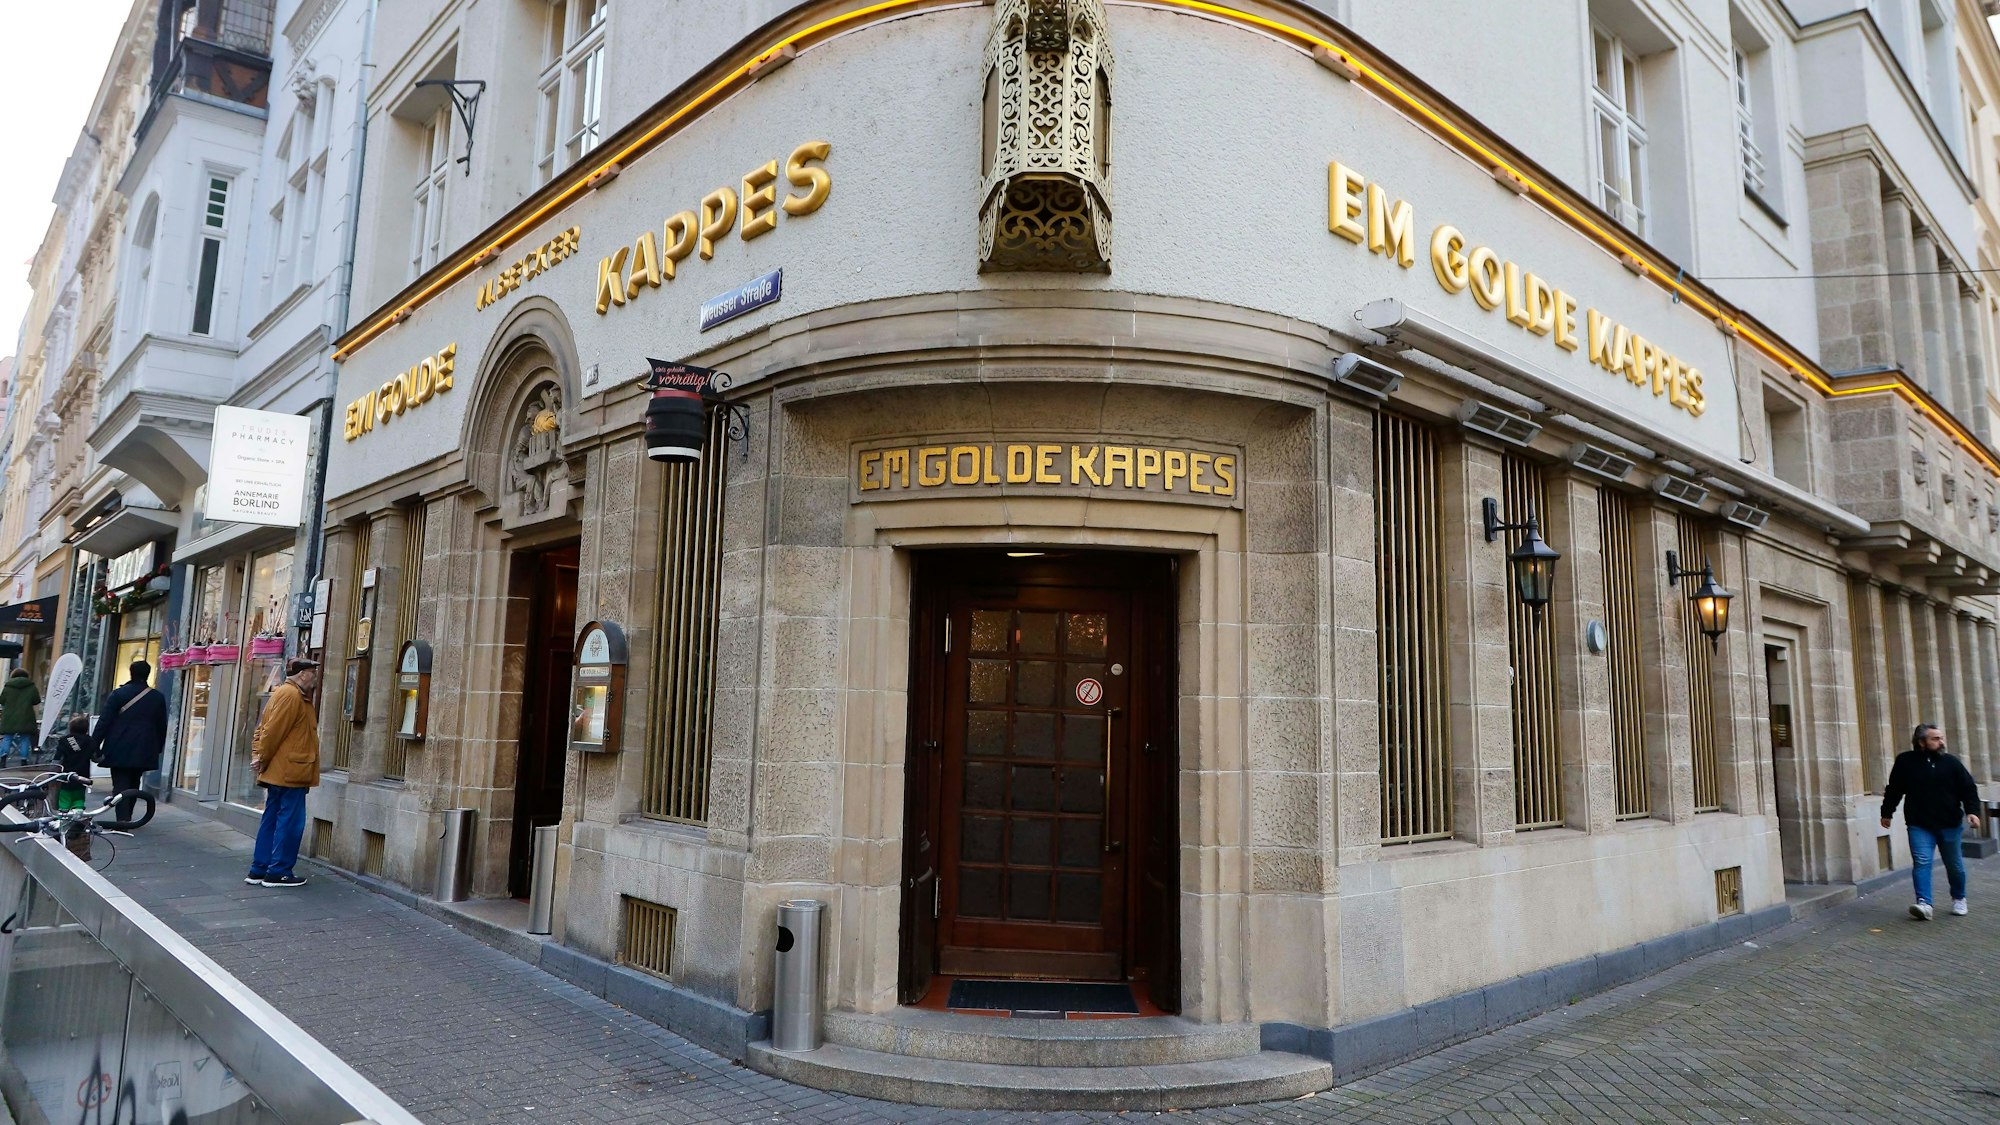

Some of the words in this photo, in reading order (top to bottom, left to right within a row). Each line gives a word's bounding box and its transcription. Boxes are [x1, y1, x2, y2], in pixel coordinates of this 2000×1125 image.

[595, 140, 832, 315] KAPPES
[497, 224, 581, 299] BECKER
[1328, 160, 1414, 269] EM
[1430, 224, 1578, 352] GOLDE
[1587, 307, 1707, 417] KAPPES
[703, 295, 739, 323] Neusser
[740, 278, 772, 306] Straße
[344, 390, 376, 442] EM
[375, 342, 457, 424] GOLDE
[231, 431, 294, 446] PHARMACY
[234, 489, 279, 500] ANNEMARIE
[860, 449, 910, 491] EM
[918, 445, 1062, 487] GOLDE
[1071, 445, 1235, 496] KAPPES
